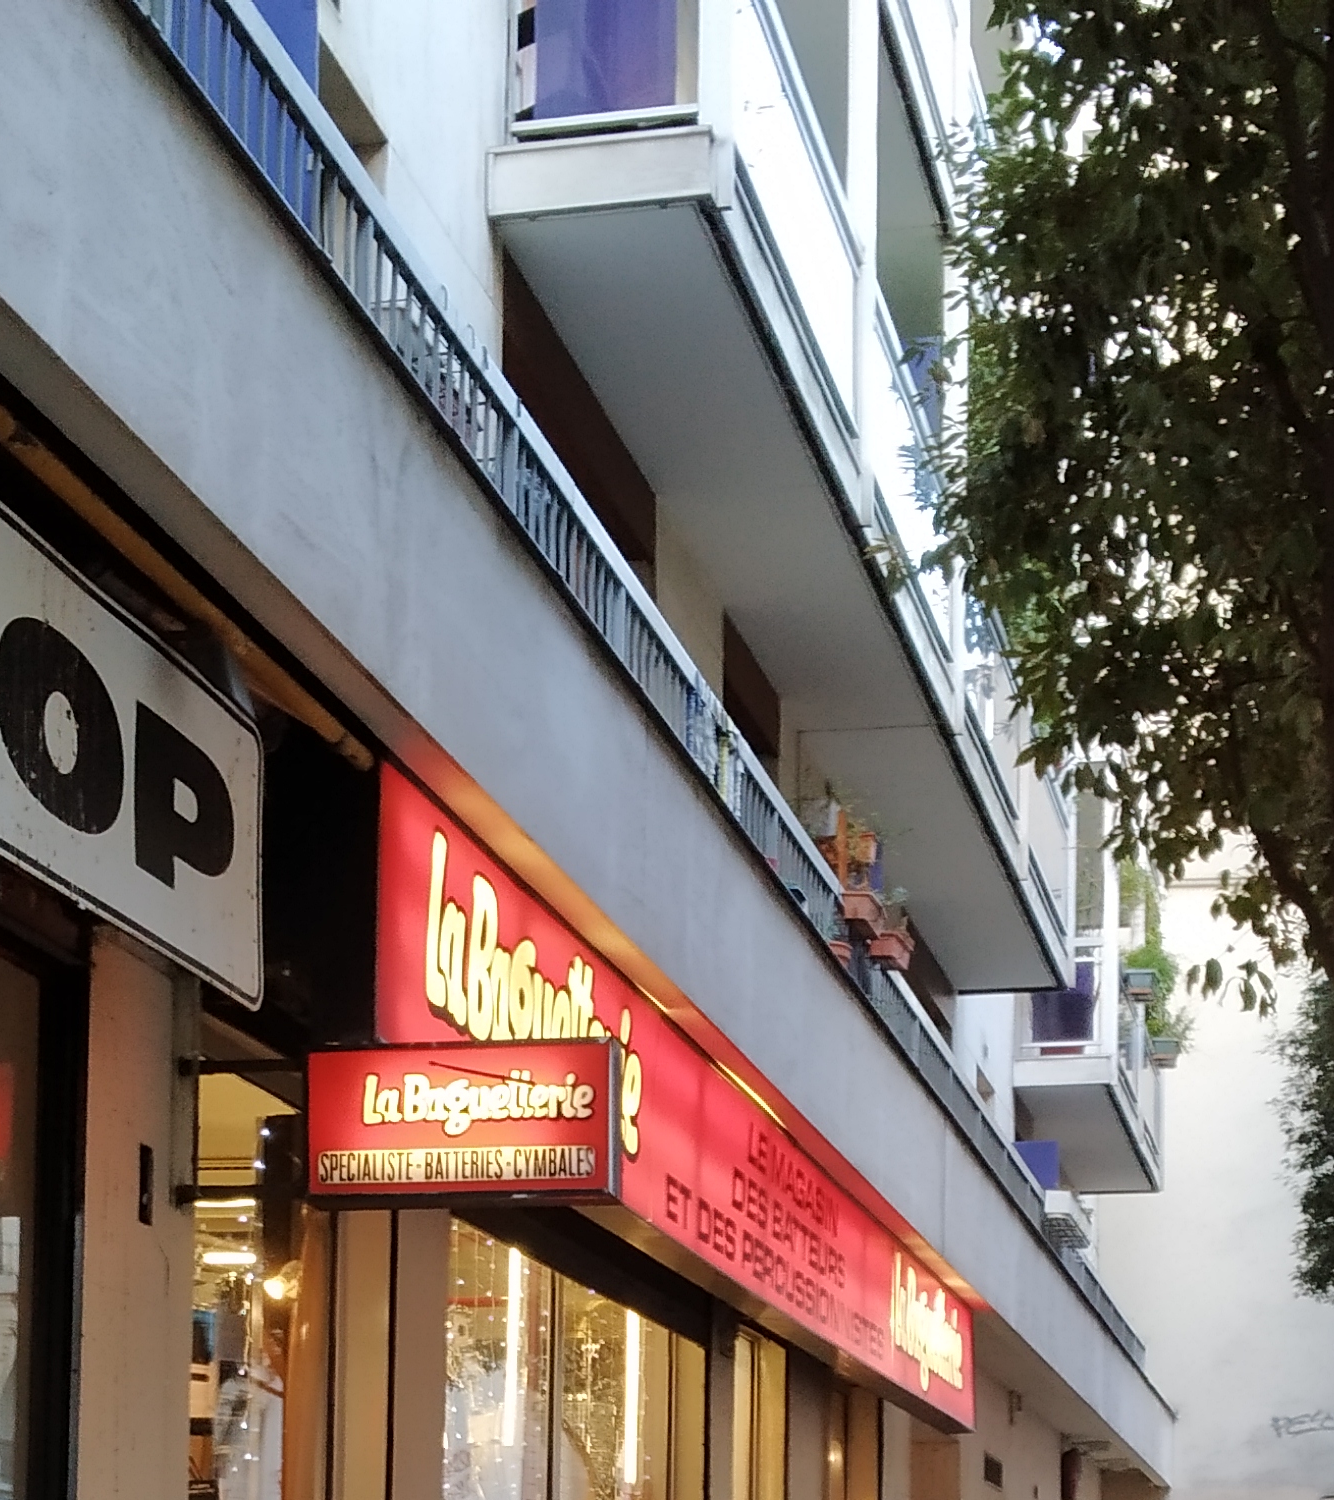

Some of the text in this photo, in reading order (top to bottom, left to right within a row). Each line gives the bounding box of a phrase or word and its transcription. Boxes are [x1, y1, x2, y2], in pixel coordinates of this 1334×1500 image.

[361, 1068, 596, 1138] La Baguetterie
[666, 1172, 692, 1231] ET
[697, 1196, 738, 1263] DES
[732, 1165, 846, 1290] DES BATTEURS
[747, 1120, 840, 1239] LE MAGASIN
